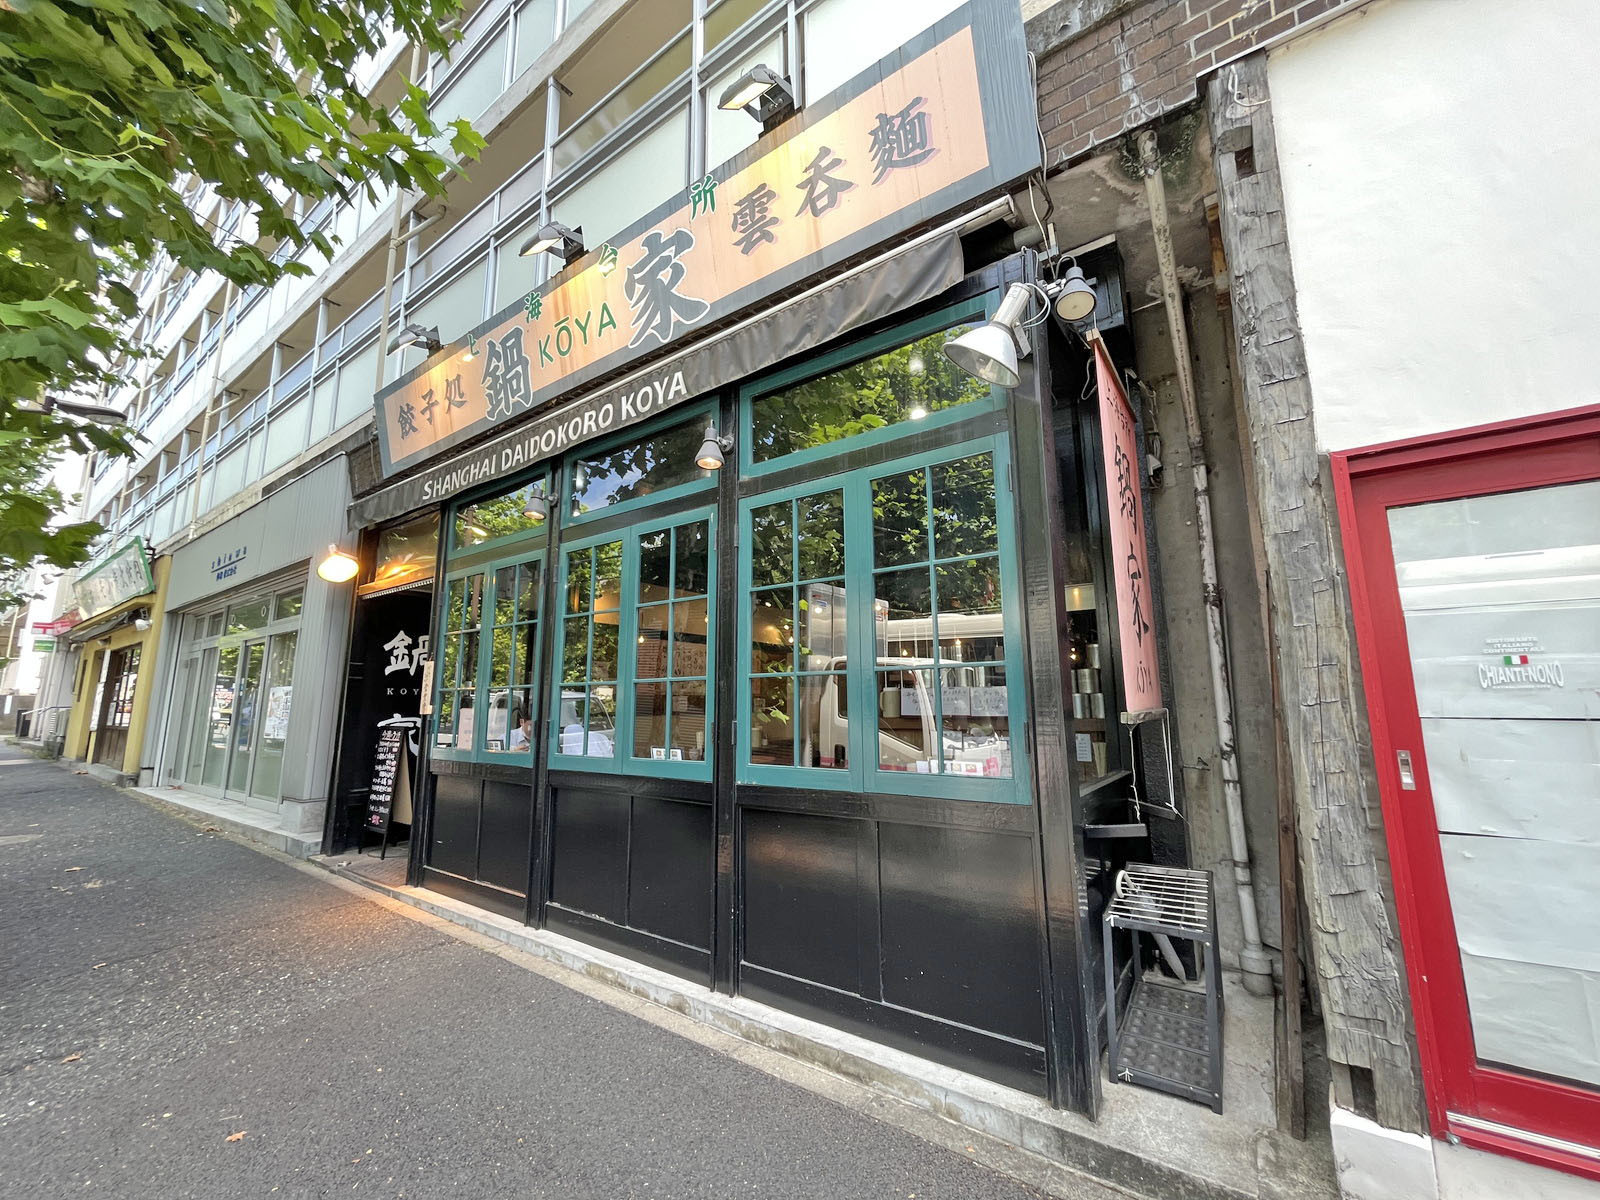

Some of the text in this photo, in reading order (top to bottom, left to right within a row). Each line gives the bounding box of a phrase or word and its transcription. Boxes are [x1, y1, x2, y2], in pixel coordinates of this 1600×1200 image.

[482, 327, 532, 419] 鍋
[625, 229, 710, 347] 家
[422, 371, 689, 501] SHANGHAI DAIDOKORO KOYA
